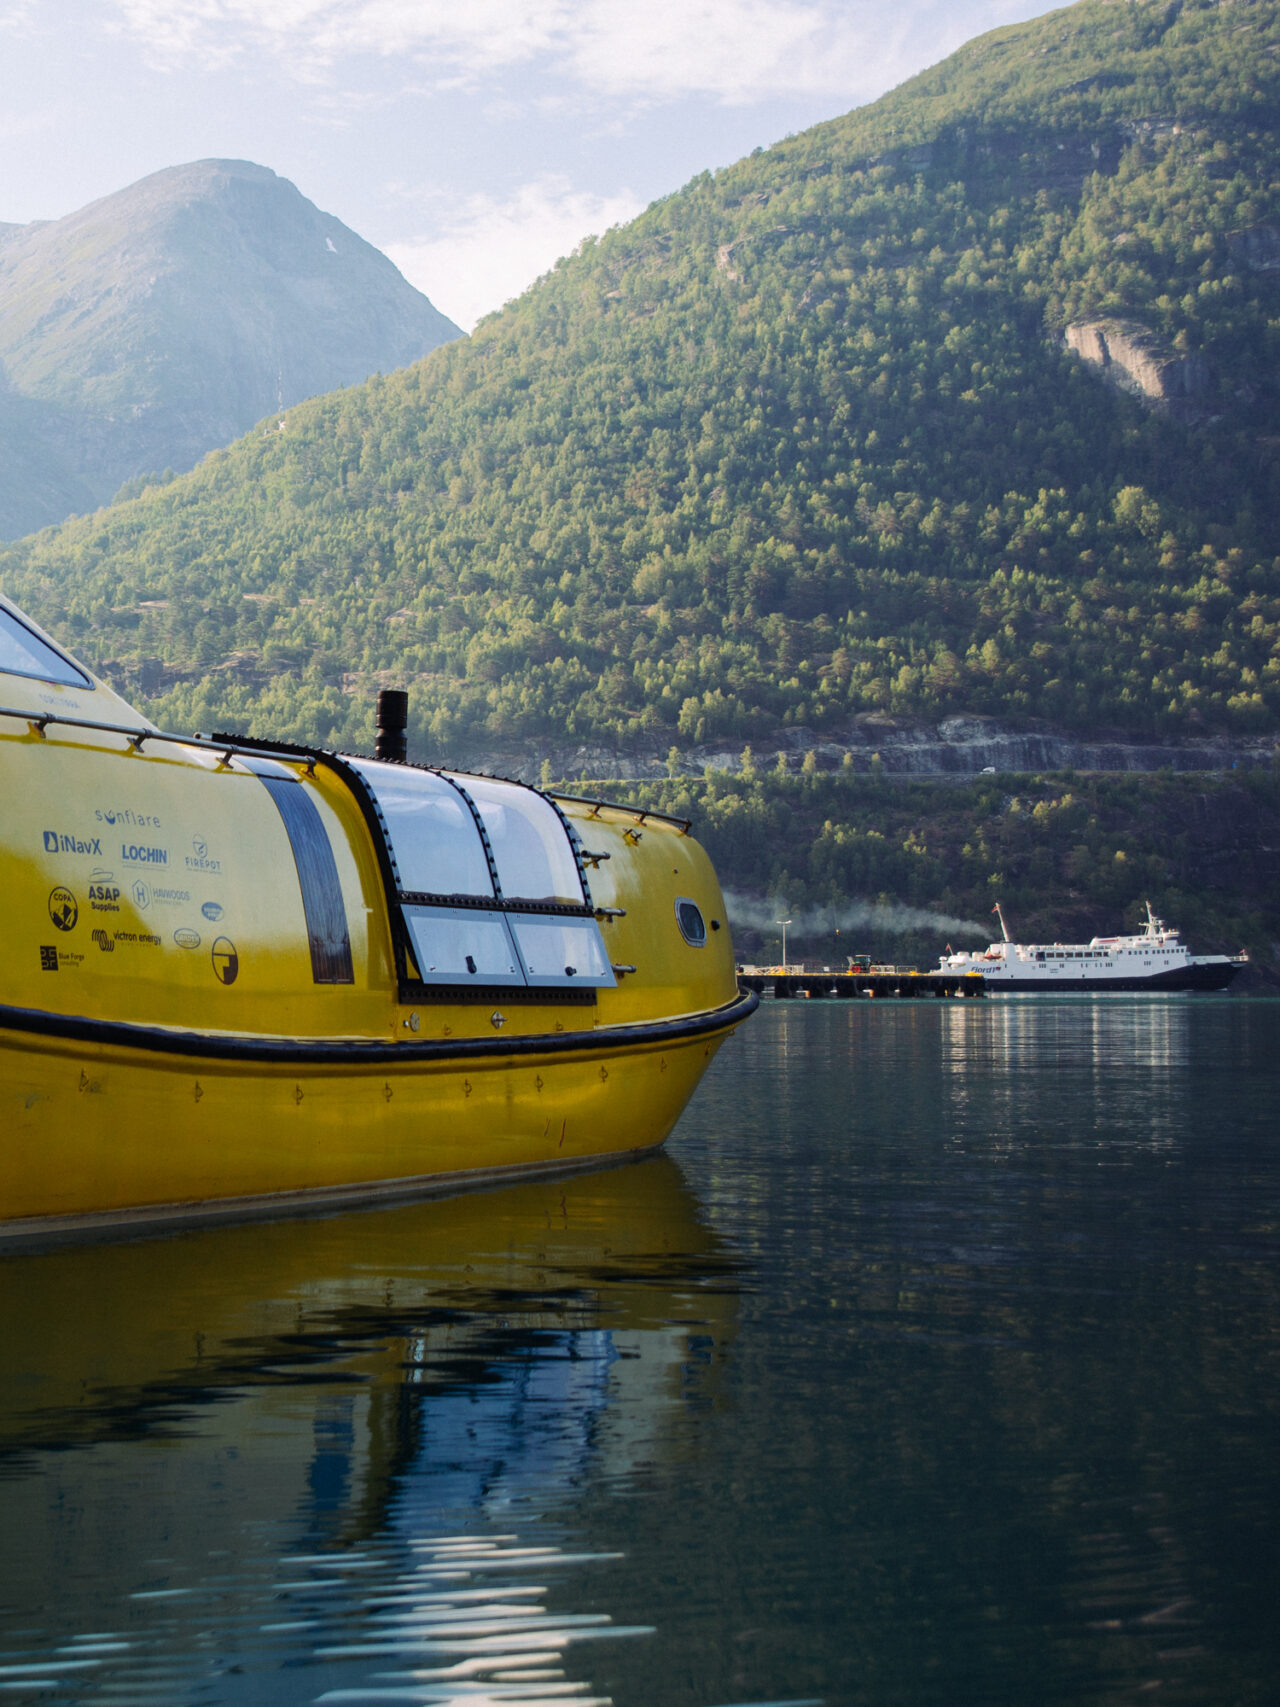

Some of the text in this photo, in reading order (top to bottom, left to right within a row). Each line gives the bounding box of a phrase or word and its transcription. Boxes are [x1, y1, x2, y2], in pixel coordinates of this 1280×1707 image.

[60, 835, 103, 856] iNavX
[122, 844, 168, 864] LOCHIN
[53, 892, 72, 903] COPA
[88, 886, 120, 901] ASAP
[91, 901, 120, 912] Supplies
[113, 930, 137, 943] victron
[139, 933, 161, 946] energy
